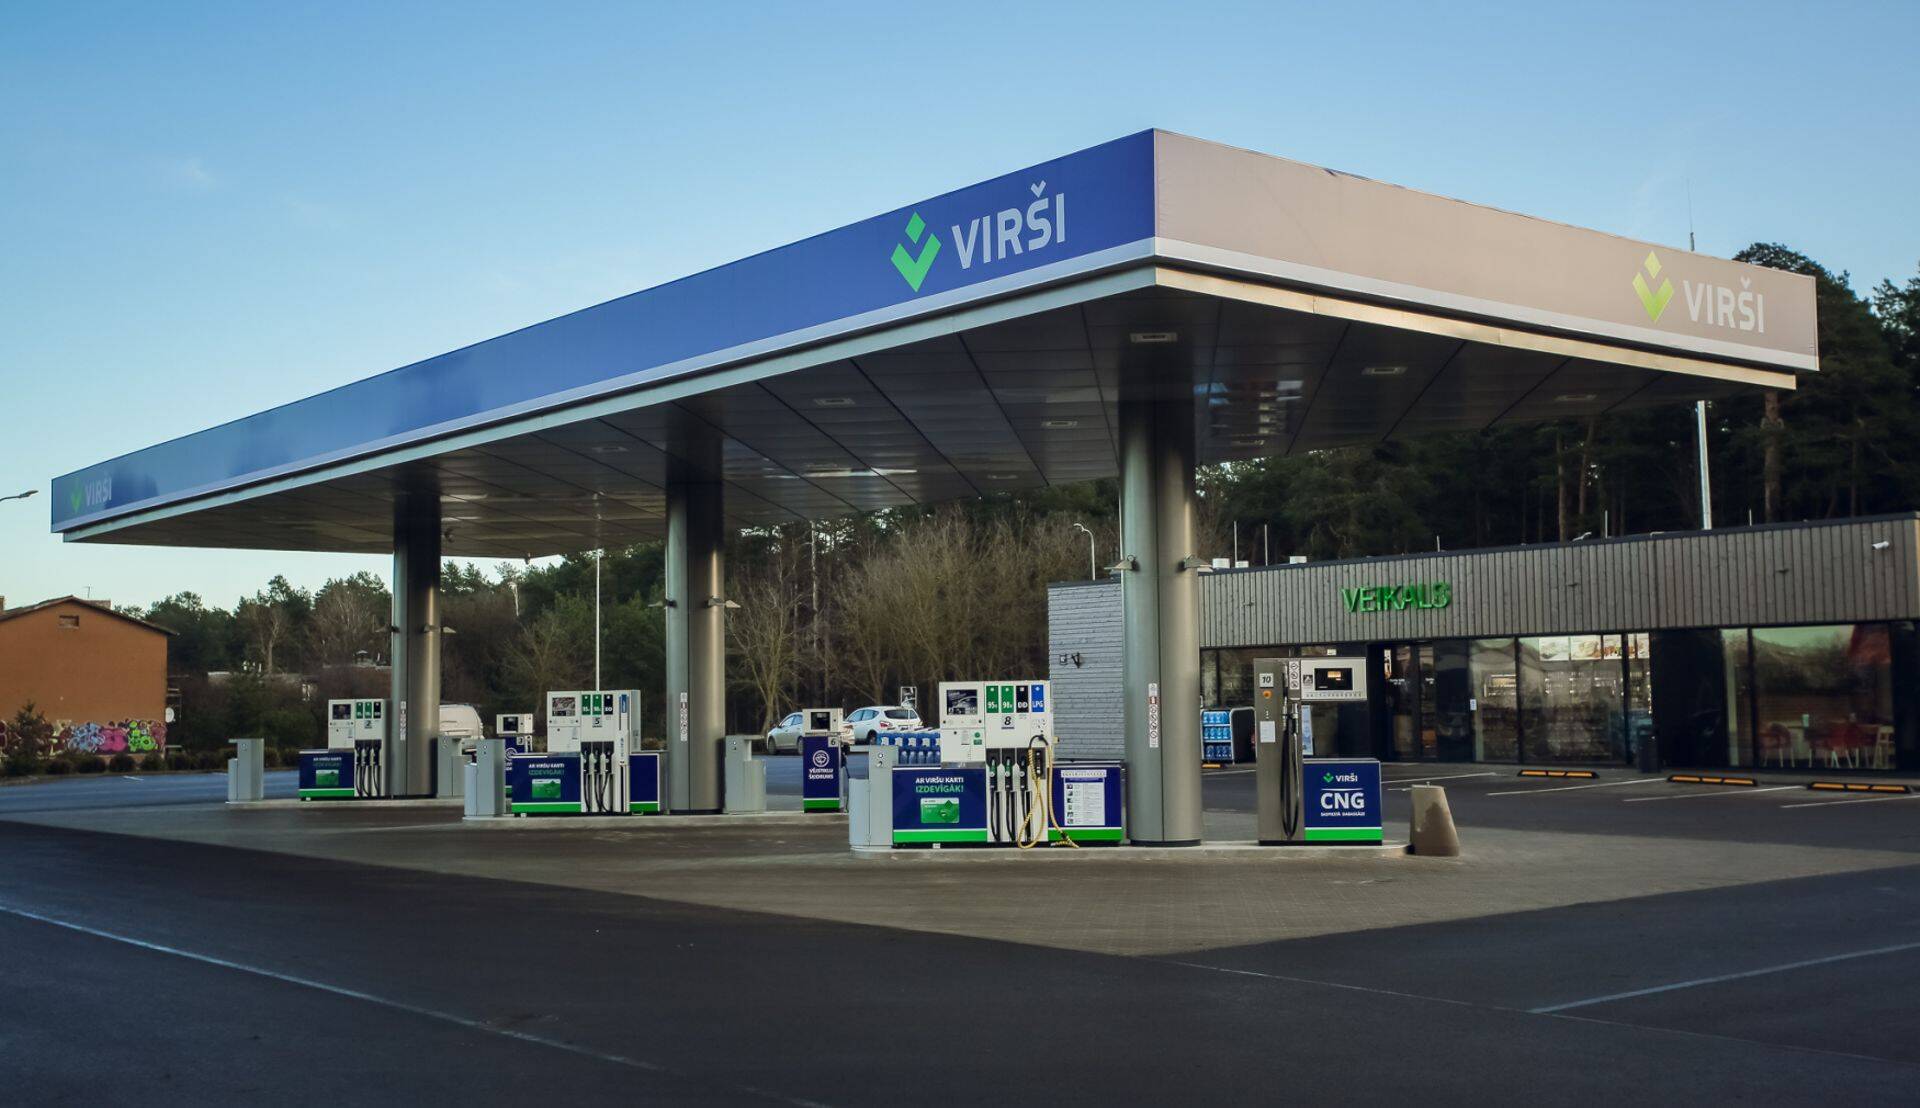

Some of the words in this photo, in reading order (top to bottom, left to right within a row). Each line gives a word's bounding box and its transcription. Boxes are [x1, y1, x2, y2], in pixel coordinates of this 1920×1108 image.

[952, 180, 1066, 270] VIRŠI
[1683, 276, 1764, 333] VIRŠI
[1341, 582, 1450, 612] VEIKALS
[1262, 676, 1271, 684] 10
[1032, 700, 1044, 708] LPG
[1004, 716, 1012, 725] 8
[1335, 772, 1358, 782] VIRŠI
[1320, 792, 1365, 809] CNG
